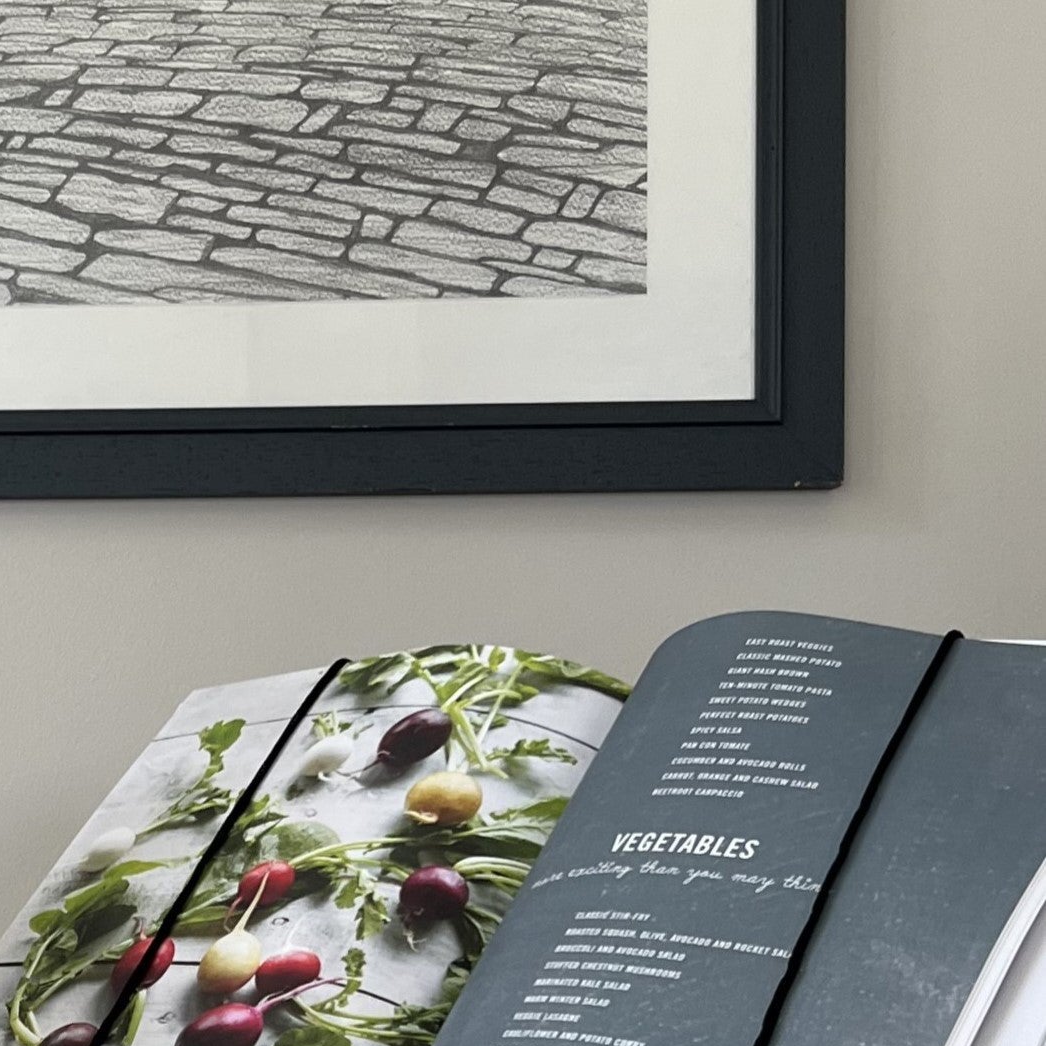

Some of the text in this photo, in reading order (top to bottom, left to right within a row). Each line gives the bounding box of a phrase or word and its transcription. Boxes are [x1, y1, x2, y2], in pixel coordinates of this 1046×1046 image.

[768, 639, 795, 647] ROAST
[797, 641, 833, 652] VEGGIES
[772, 654, 808, 663] MASHED
[808, 657, 842, 668] POTATO
[777, 669, 809, 678] BROWN
[770, 683, 804, 693] TOMATO
[804, 686, 832, 696] PASTA
[737, 697, 769, 705] POTATO
[770, 699, 807, 708] WEDGES
[699, 711, 810, 724] PERFECT ROAST POTATOES
[690, 727, 716, 735] SPICY
[717, 742, 751, 751] TOMATE
[671, 757, 717, 765] CUCUMBER
[736, 759, 777, 769] AVOCADO
[777, 762, 807, 772] ROLLS
[696, 773, 732, 781] ORANGE
[732, 774, 751, 782] AND
[752, 776, 789, 786] CASHEW
[790, 779, 819, 790] SALAD
[651, 788, 745, 798] BEETROOT CARPACCIO
[611, 832, 760, 860] VEGETABLES
[568, 861, 633, 879] exciting
[640, 861, 680, 875] than
[682, 867, 723, 885] you
[731, 873, 774, 893] may
[783, 875, 821, 892] thin
[564, 928, 602, 936] ROASTED
[670, 934, 712, 947] AVOCADO
[712, 939, 732, 949] AND
[733, 943, 771, 955] ROCKET
[771, 948, 792, 959] SAL
[554, 944, 686, 961] BROCCOLI AND AVOCADO SALAD
[544, 961, 682, 979] STUFFED CHESTNUT MUSHROOMS
[602, 981, 631, 991] SALAD
[581, 997, 611, 1007] SALAD
[542, 1012, 581, 1022] LASAGNE
[502, 1030, 559, 1038] CAULIFLOWER
[559, 1031, 579, 1041] AND
[578, 1033, 613, 1045] POTATO
